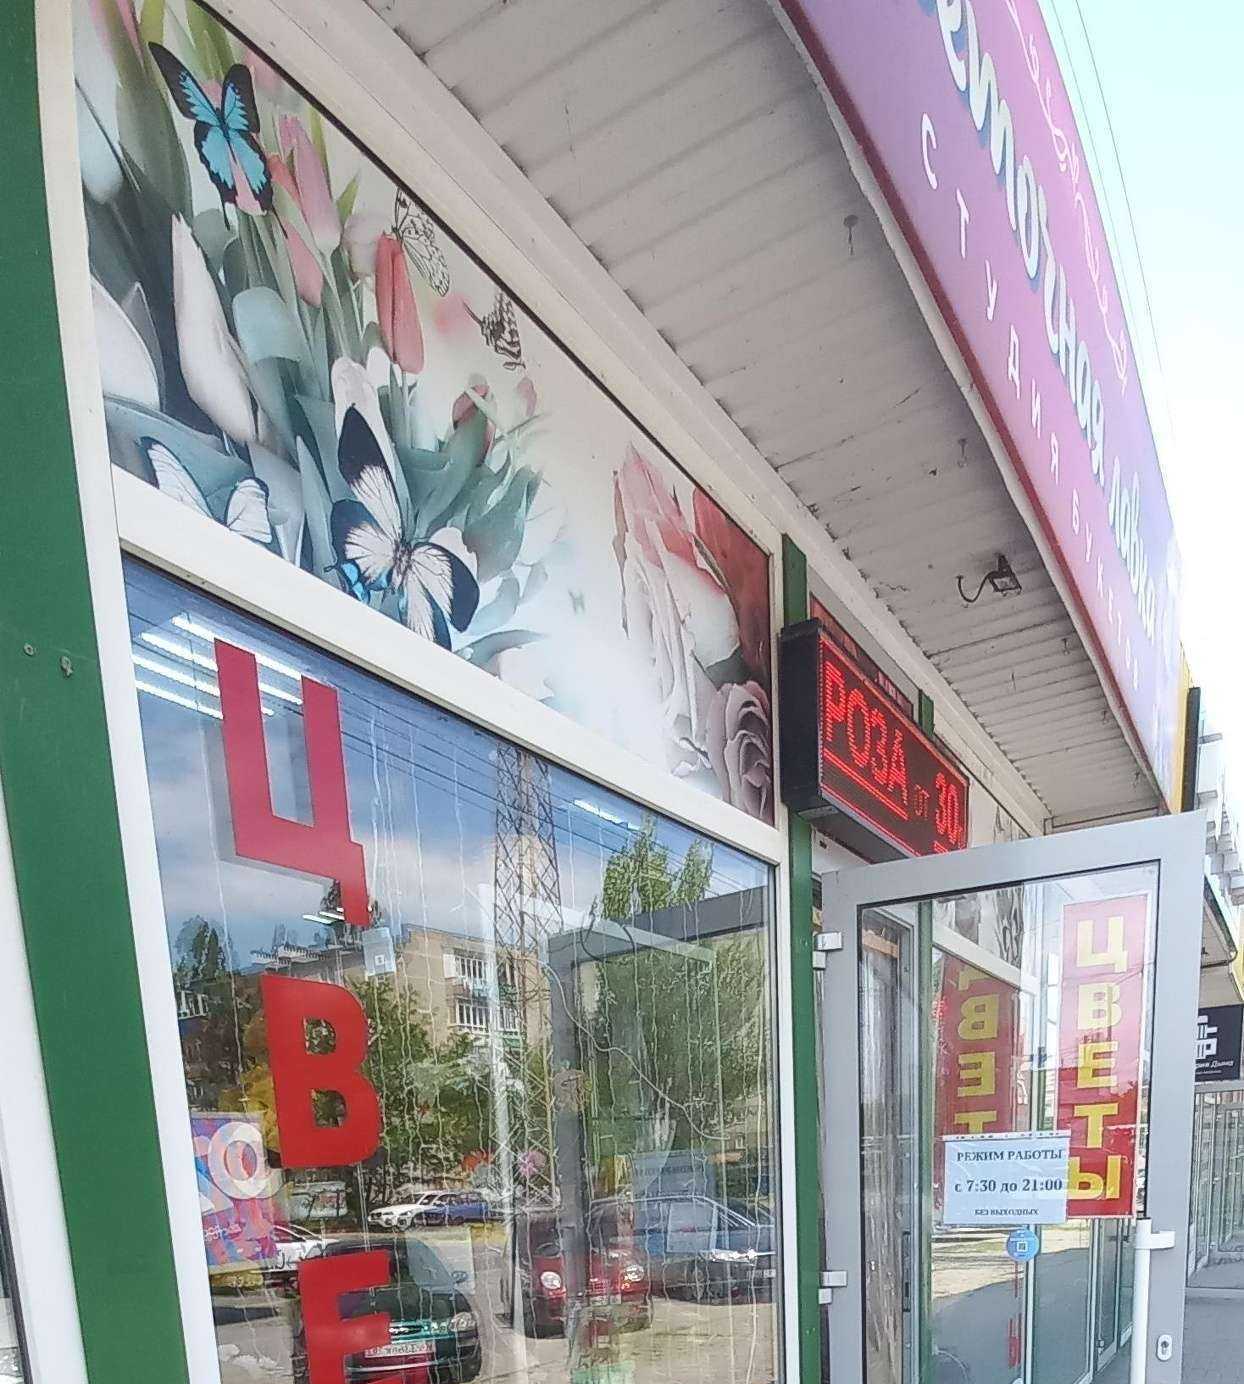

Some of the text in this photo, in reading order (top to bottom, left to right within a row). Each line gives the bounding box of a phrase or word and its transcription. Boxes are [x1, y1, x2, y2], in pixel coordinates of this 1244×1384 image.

[922, 113, 1058, 485] СТУДИЯ
[935, 0, 1104, 488] еточная
[824, 661, 908, 805] РОЗА
[1068, 915, 1128, 1202] ЦВЕТЫ
[954, 1178, 1063, 1193] с 7:30 до 21:00
[957, 1149, 1062, 1161] РЕЖИМ РАБОТЫ
[990, 1208, 1040, 1216] ВЫХОДНЫХ
